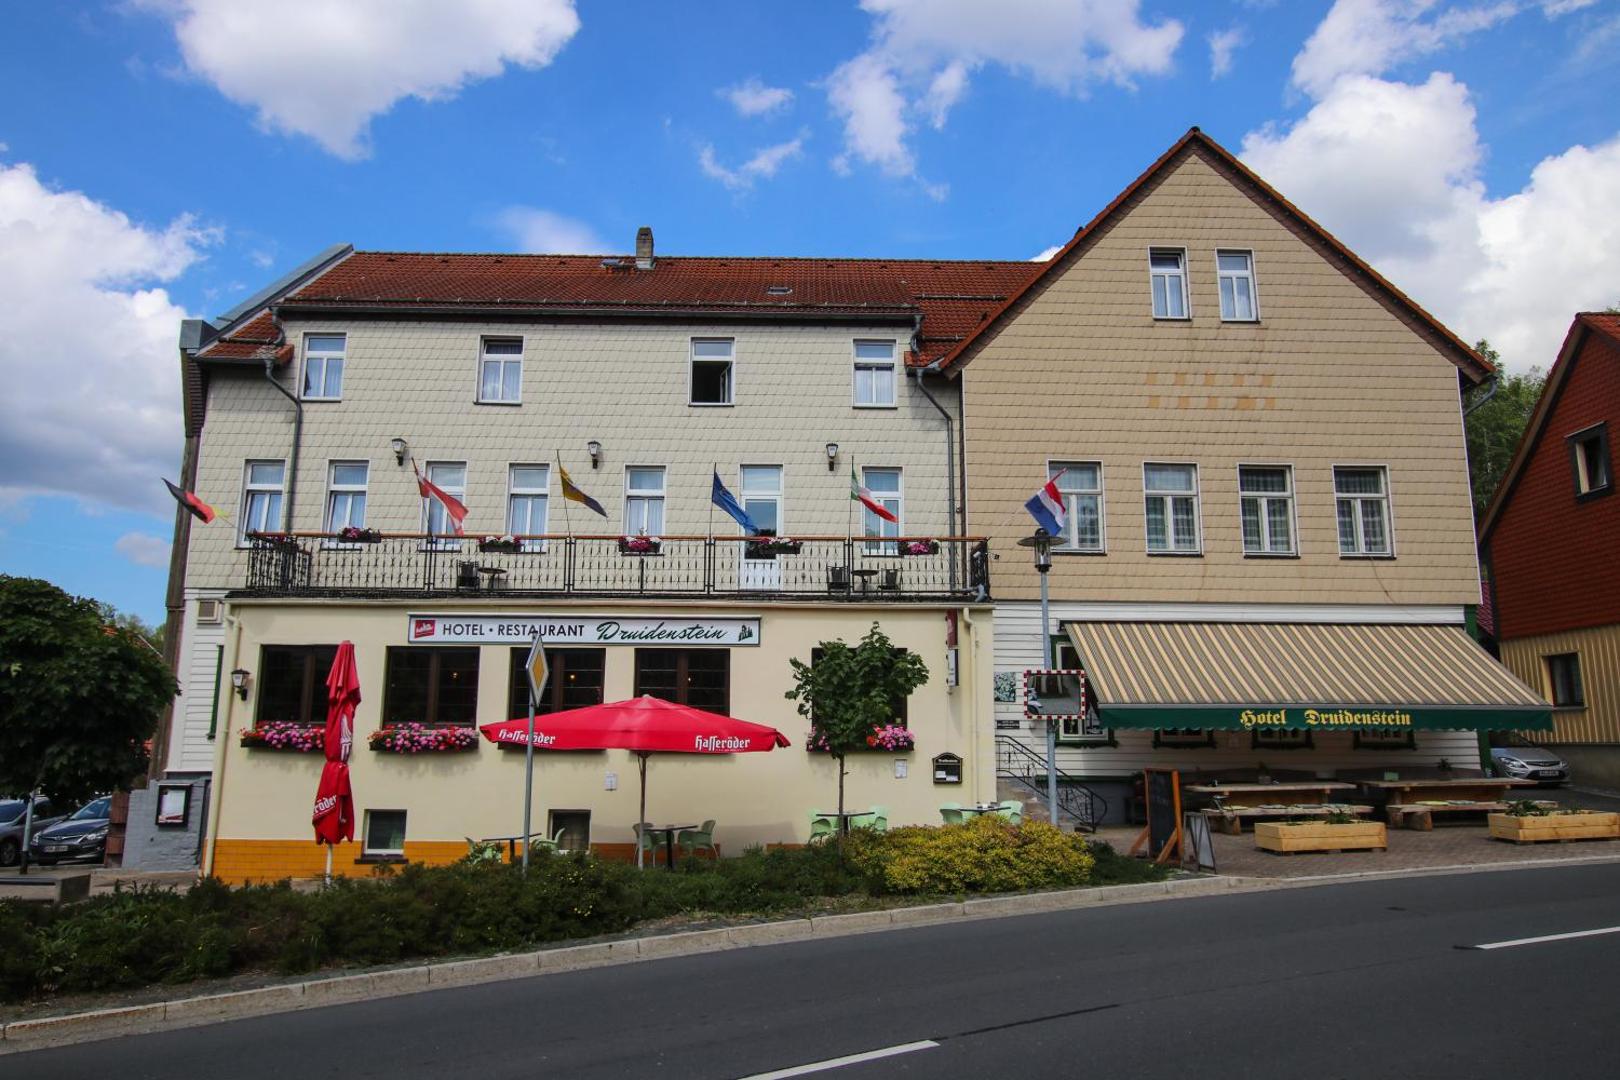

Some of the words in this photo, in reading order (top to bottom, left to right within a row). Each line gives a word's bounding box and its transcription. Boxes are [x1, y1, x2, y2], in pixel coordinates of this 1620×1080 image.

[443, 623, 485, 636] HOTEL
[497, 624, 585, 637] RESTAURANT
[596, 621, 727, 641] Druidenstein
[1240, 709, 1287, 730] Hotel
[1304, 708, 1411, 726] Druidenstein
